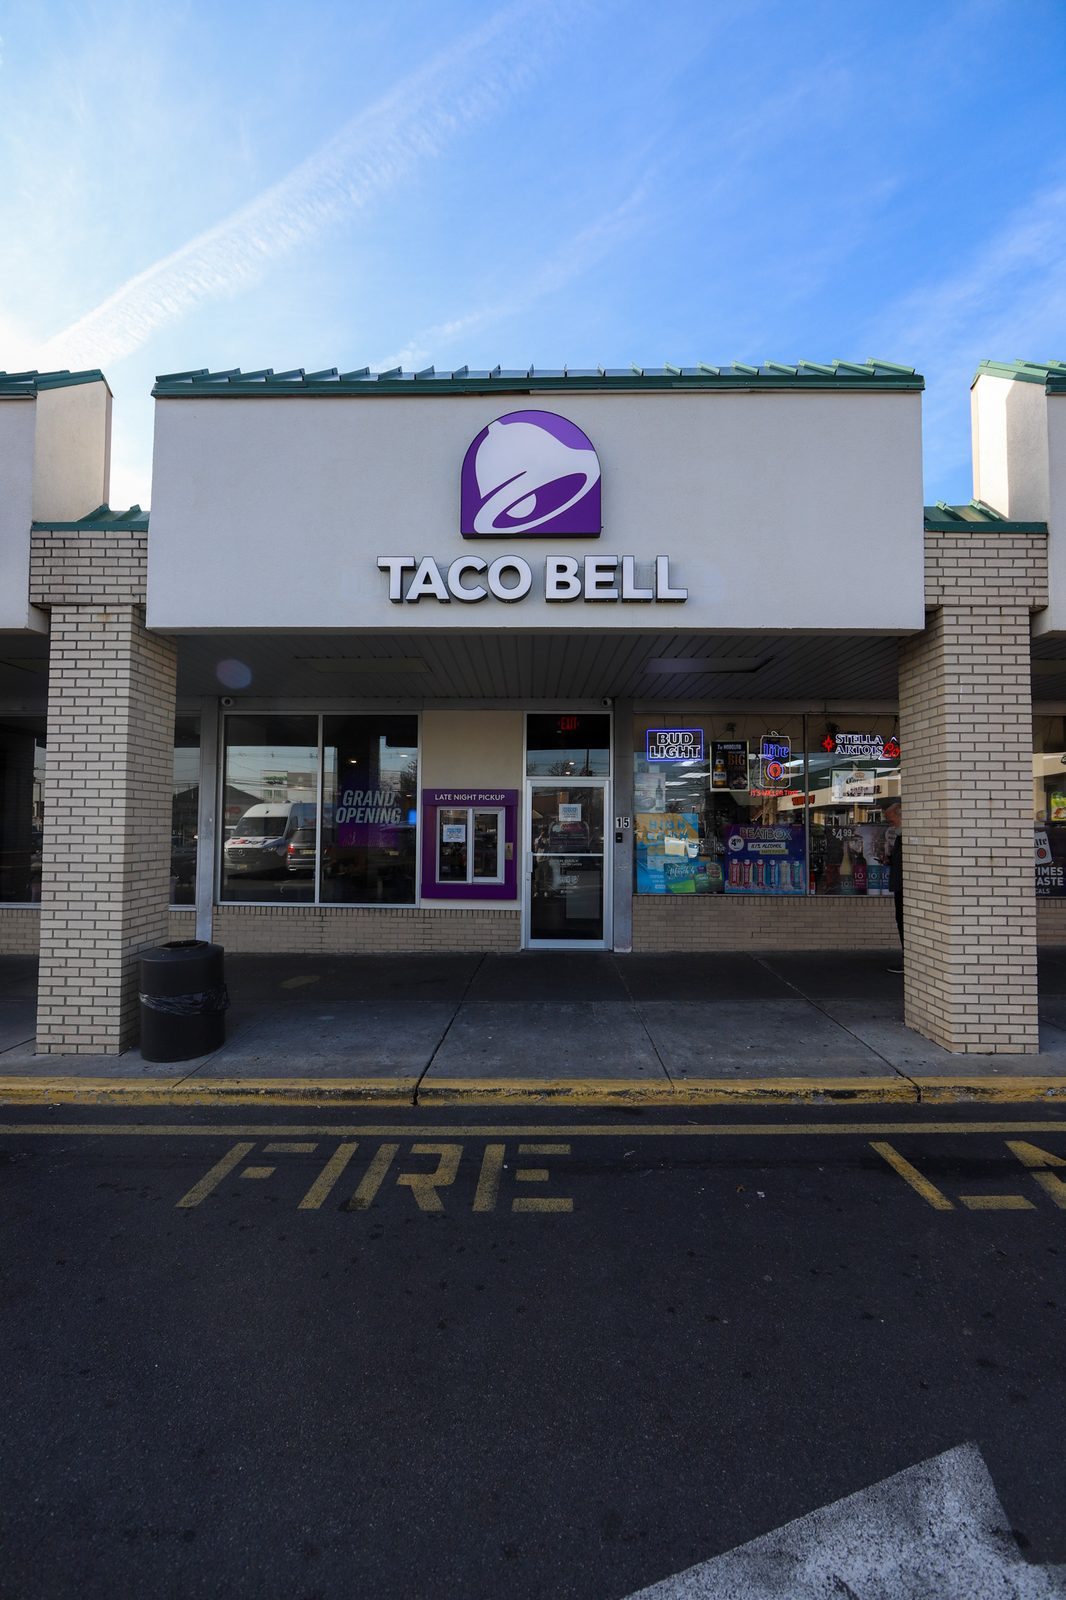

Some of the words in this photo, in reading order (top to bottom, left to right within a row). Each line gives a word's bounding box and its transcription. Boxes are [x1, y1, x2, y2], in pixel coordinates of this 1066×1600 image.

[377, 555, 532, 602] TACO
[545, 555, 688, 602] BELL
[560, 717, 577, 730] EXIT
[656, 732, 694, 745] BUD
[835, 734, 883, 745] STELLA
[649, 745, 700, 758] LIGHT
[763, 743, 790, 760] Lite
[834, 745, 884, 755] ARTOIS
[728, 754, 745, 766] BIG
[343, 790, 396, 806] GRAND
[336, 807, 402, 824] OPENING
[616, 817, 630, 828] 15
[740, 827, 793, 840] BEATBOX
[1034, 866, 1064, 876] IMES
[1034, 876, 1065, 886] ASTE
[174, 1142, 573, 1212] FIRE
